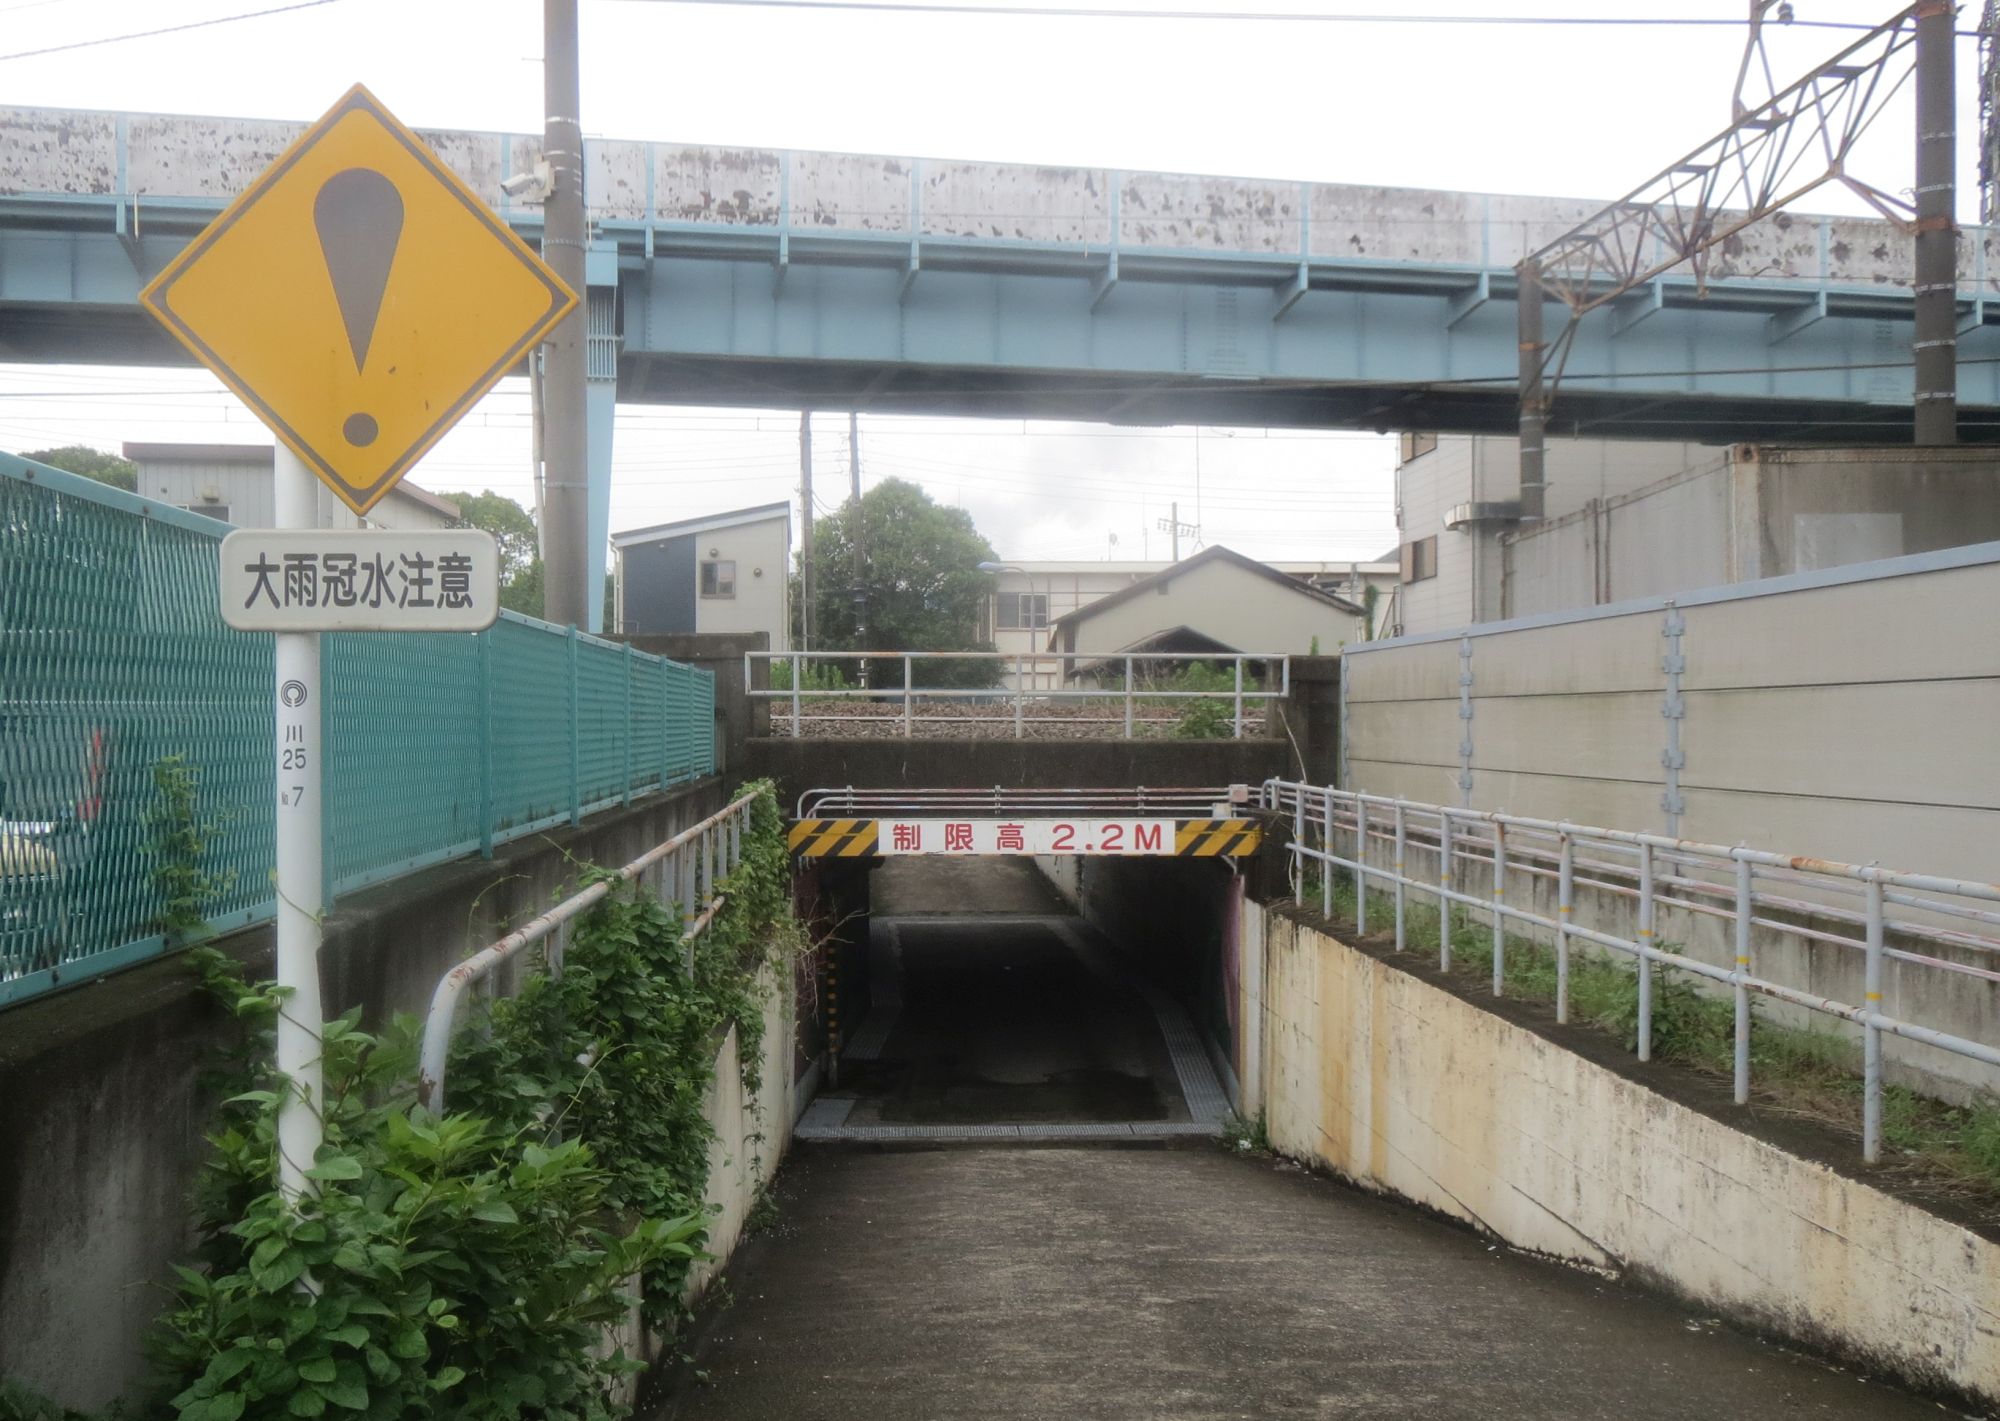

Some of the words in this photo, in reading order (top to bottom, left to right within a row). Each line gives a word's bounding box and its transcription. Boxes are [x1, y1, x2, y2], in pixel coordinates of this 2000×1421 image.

[244, 551, 473, 609] 大雨冠水注意
[285, 724, 303, 743] 川
[282, 748, 307, 770] 25
